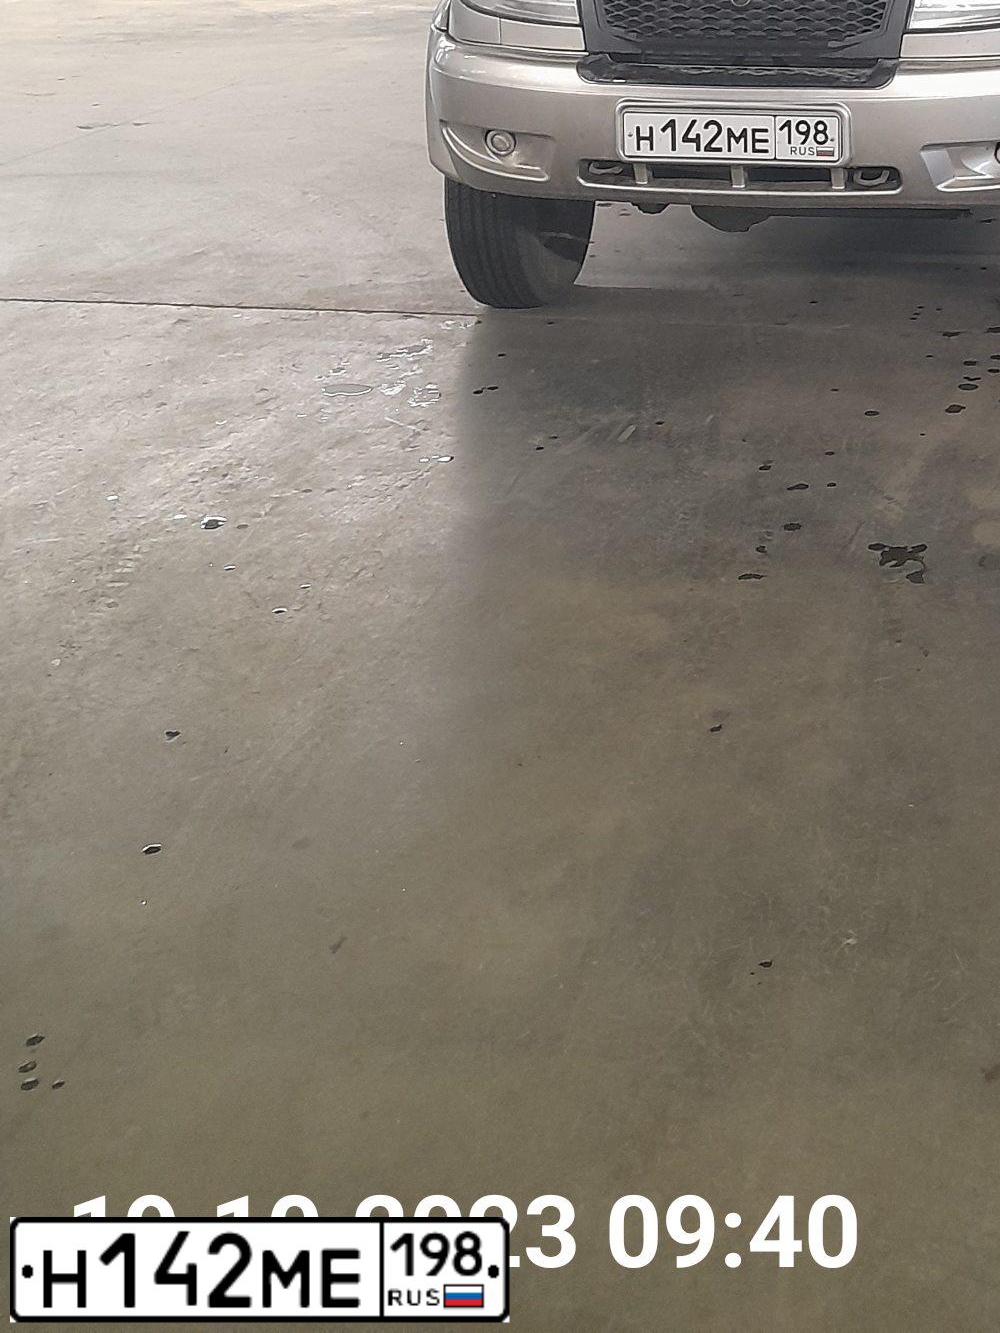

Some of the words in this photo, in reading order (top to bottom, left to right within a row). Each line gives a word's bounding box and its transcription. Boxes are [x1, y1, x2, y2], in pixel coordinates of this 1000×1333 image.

[635, 119, 769, 153] Н142МЕ
[779, 119, 828, 145] 198
[790, 147, 815, 156] RUS
